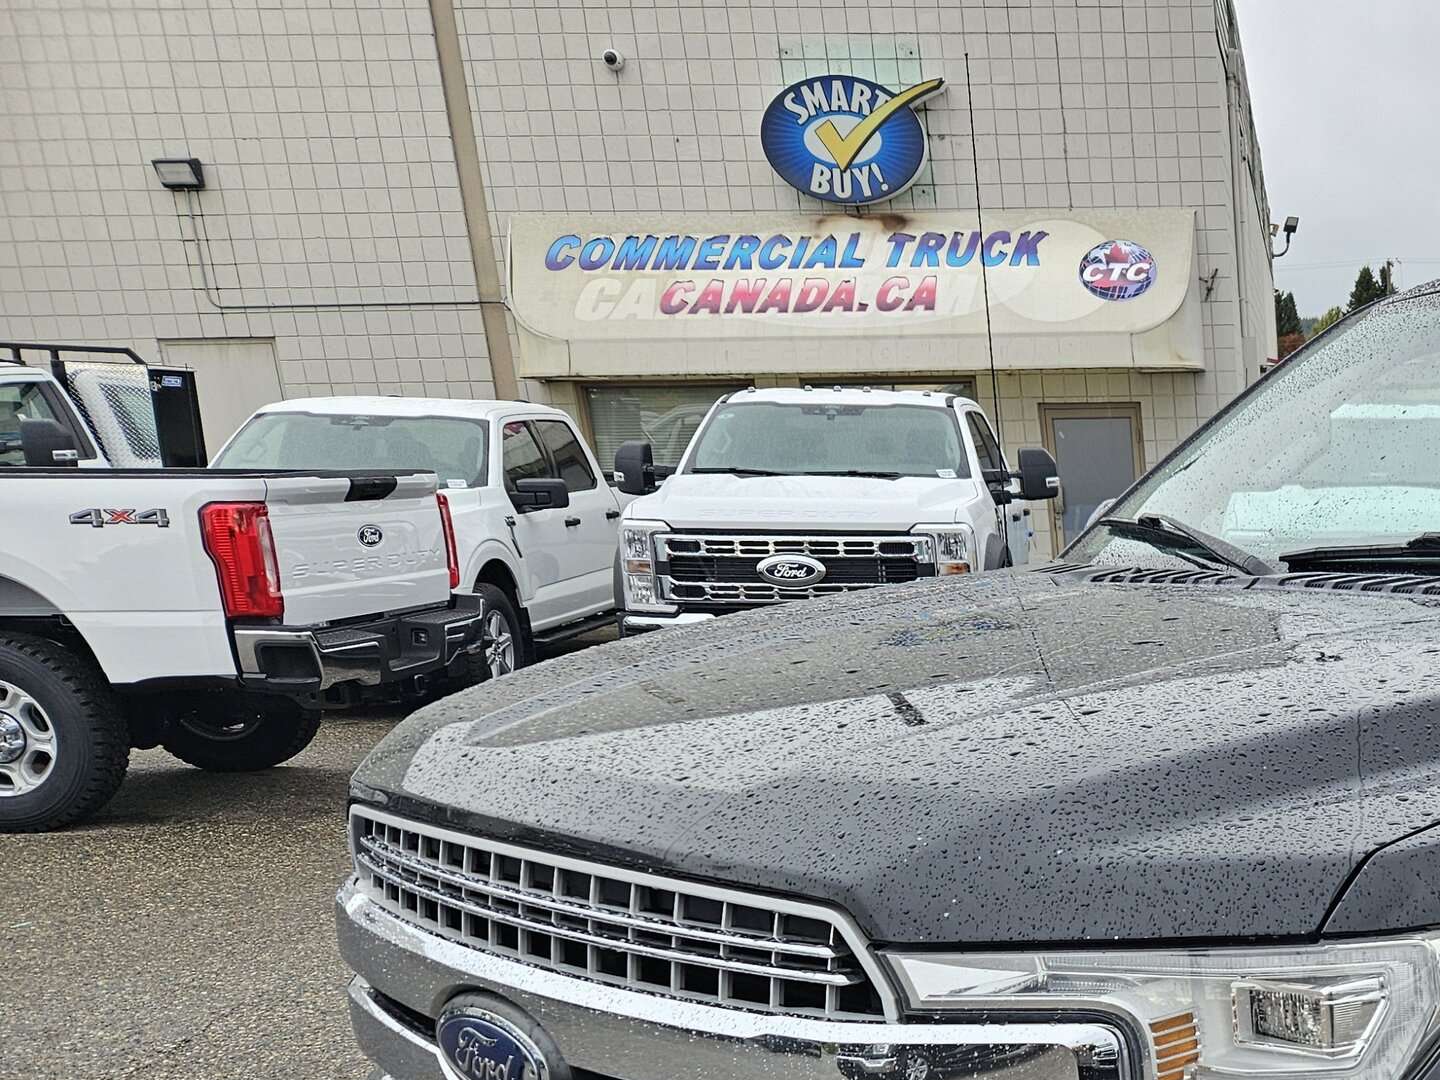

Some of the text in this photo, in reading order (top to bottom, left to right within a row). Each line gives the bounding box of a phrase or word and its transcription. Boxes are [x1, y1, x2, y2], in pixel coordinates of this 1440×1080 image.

[784, 80, 893, 125] SMART
[810, 162, 889, 199] BUY!
[544, 230, 1050, 271] COMMERCIAL TRUCK
[1082, 262, 1153, 282] CTC
[659, 275, 938, 316] CANADA.CA
[773, 562, 808, 580] Ford
